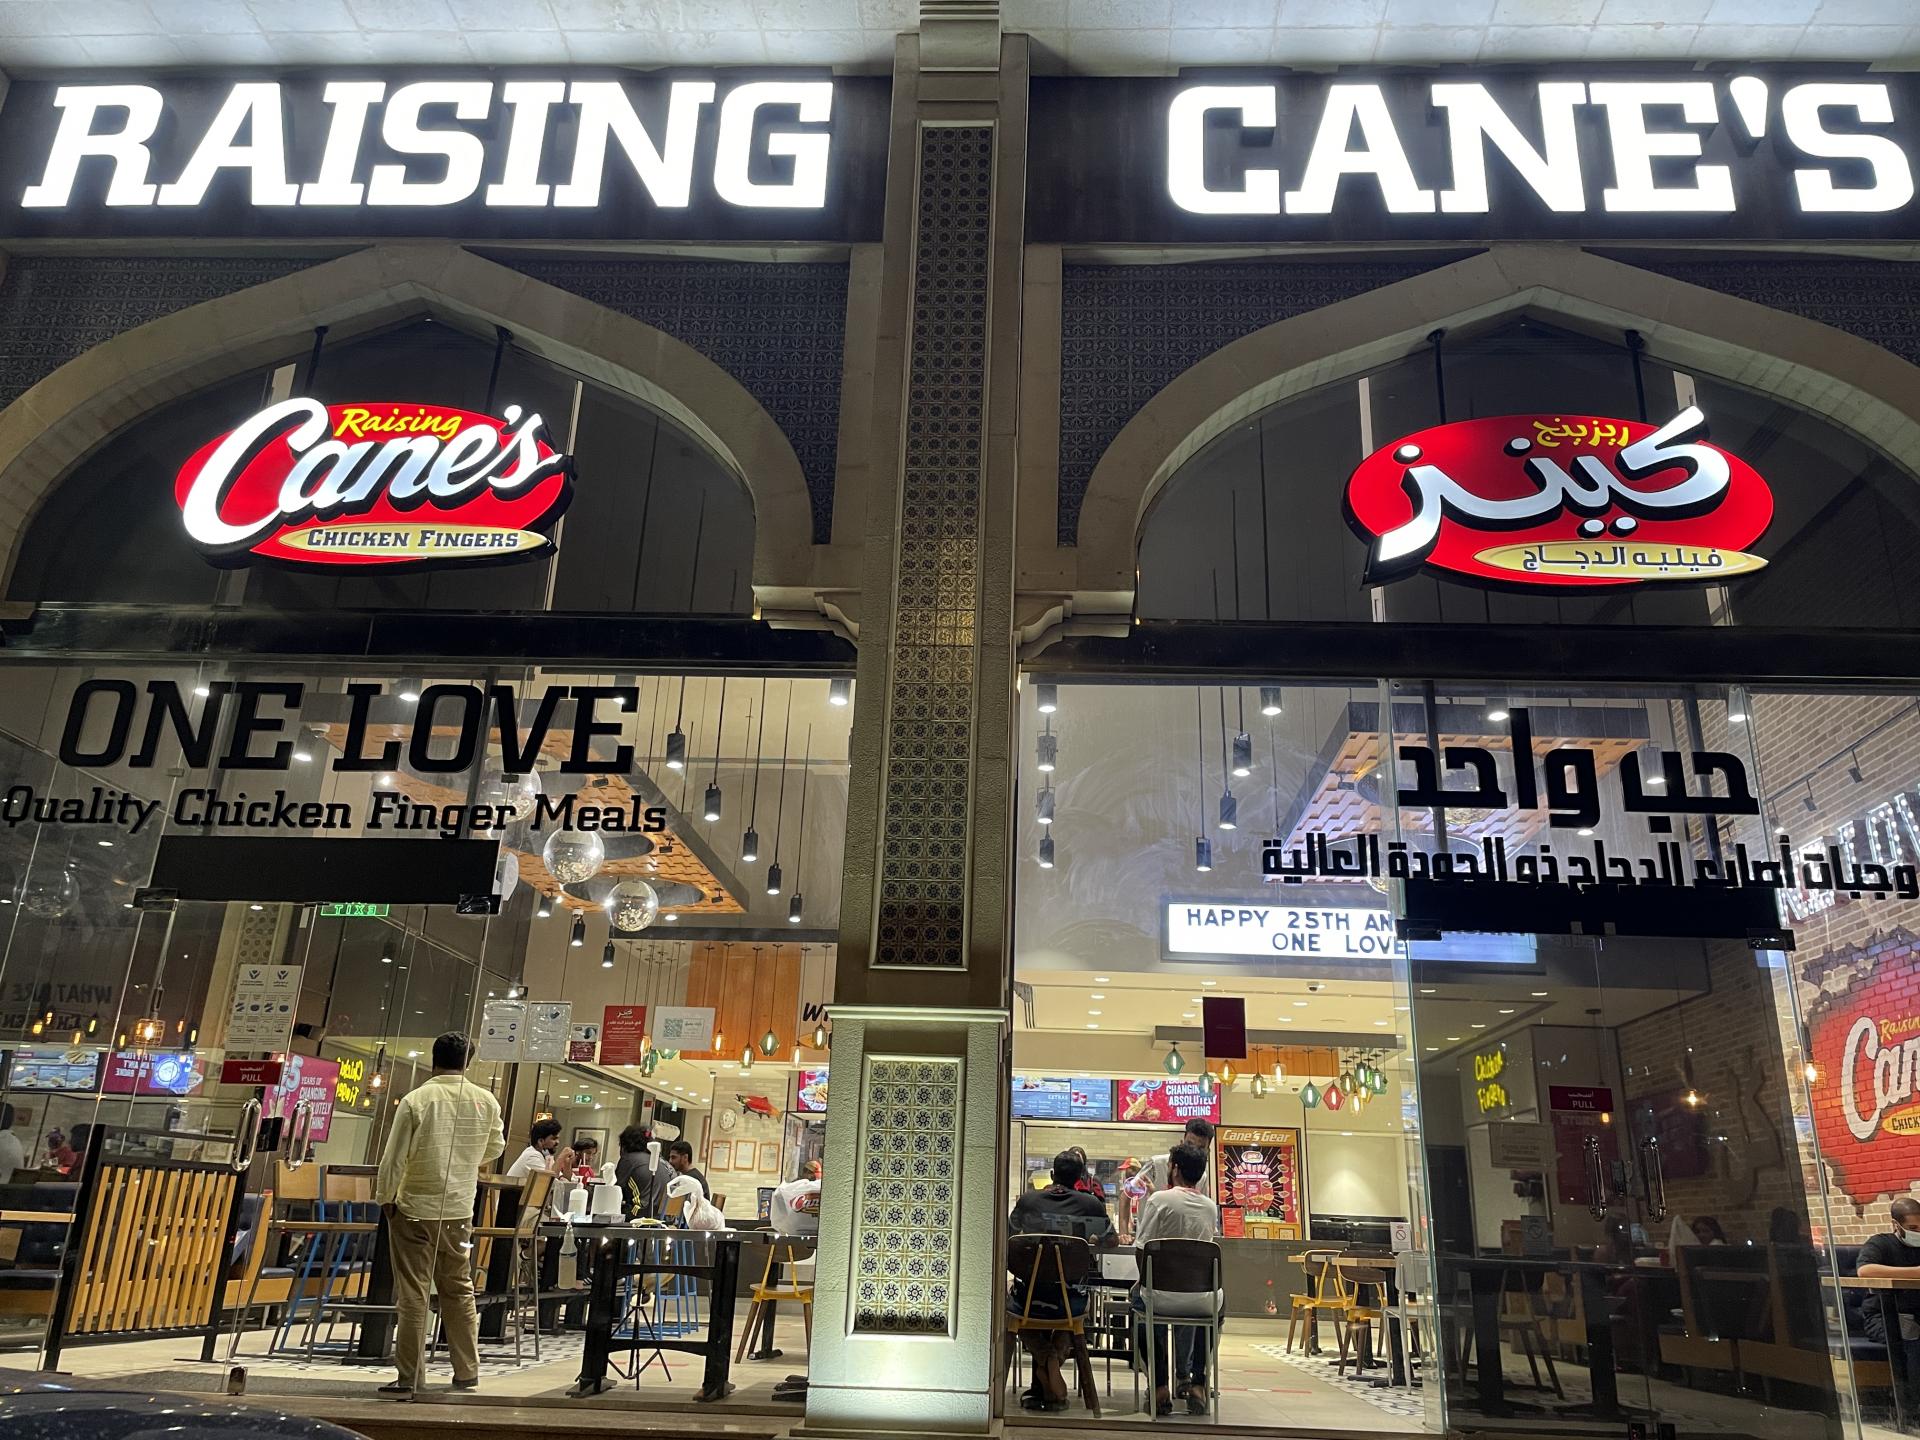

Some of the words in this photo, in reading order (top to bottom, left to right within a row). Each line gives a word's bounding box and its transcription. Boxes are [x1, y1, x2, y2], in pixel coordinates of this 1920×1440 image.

[21, 82, 833, 208] RAISING
[1168, 75, 1914, 213] CANE'S
[334, 408, 463, 440] Raising
[1533, 417, 1630, 448] ريزينج
[182, 397, 562, 545] Cane's
[1379, 405, 1730, 562] كينز
[307, 529, 410, 547] CHICKEN
[417, 530, 519, 548] FINGERS
[1522, 545, 1626, 571] الدجاج
[1633, 547, 1724, 572] فيليه
[58, 678, 304, 770] ONE
[333, 683, 639, 774] LOVE
[1397, 708, 1599, 828] واحد
[1619, 751, 1759, 833] حب
[3, 785, 160, 833] Quality
[174, 788, 352, 829] Chicken
[367, 792, 517, 840] Finger
[531, 794, 667, 832] Meals
[1262, 833, 1379, 884] العالية
[1803, 846, 1919, 900] وجبات
[1187, 909, 1269, 928] HAPPY
[1287, 911, 1350, 931] 25TH
[1272, 933, 1321, 952] ONE
[1345, 935, 1406, 955] LOVE
[241, 1073, 262, 1082] PULL
[1176, 1106, 1211, 1117] NOTHING
[1572, 1100, 1596, 1109] PULL
[1222, 1129, 1260, 1142] Cane's
[1261, 1130, 1291, 1142] Gear
